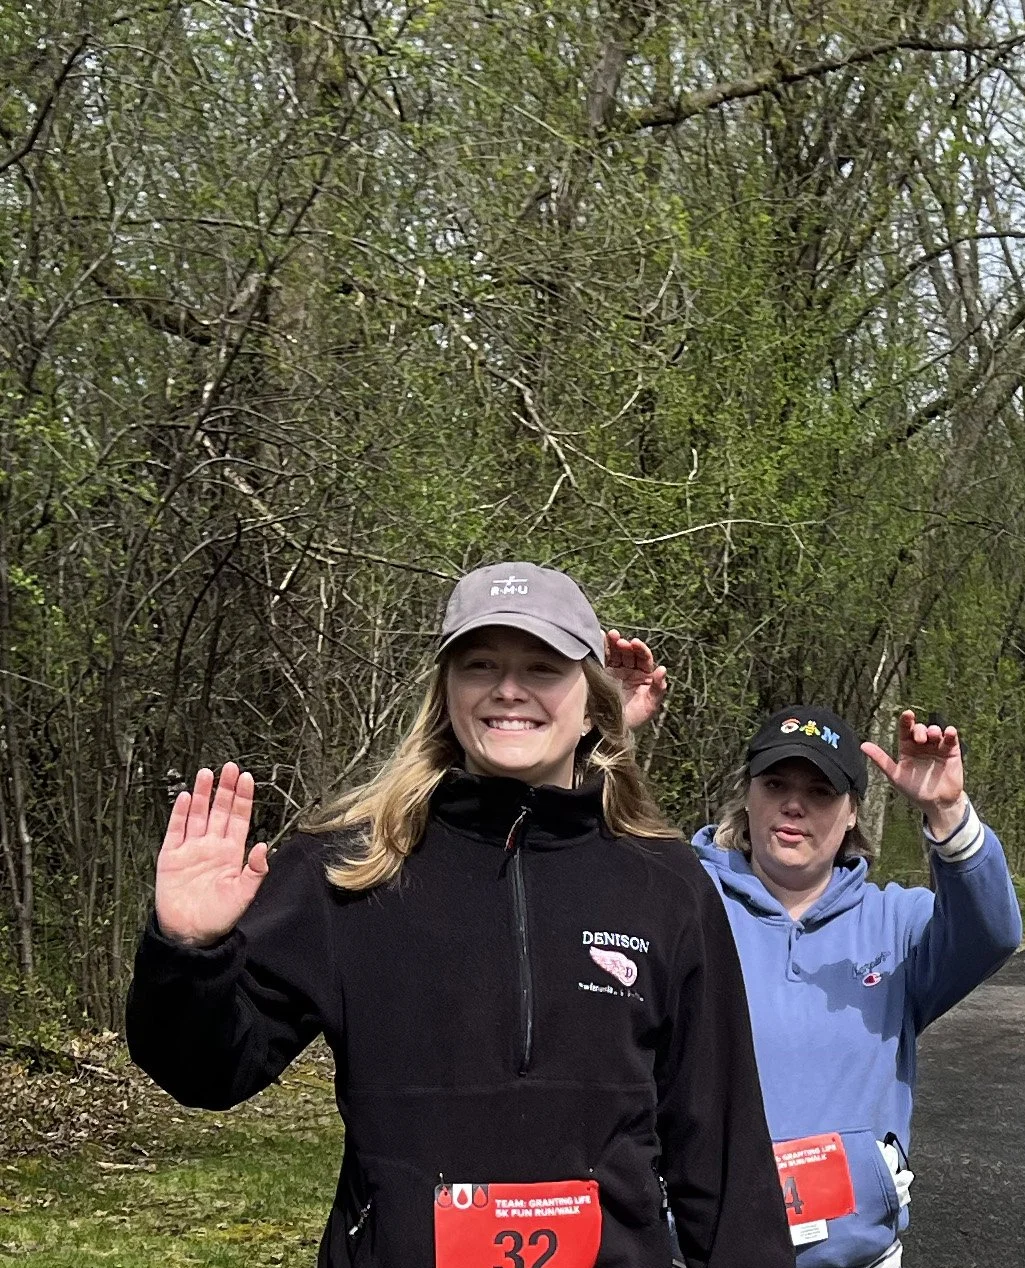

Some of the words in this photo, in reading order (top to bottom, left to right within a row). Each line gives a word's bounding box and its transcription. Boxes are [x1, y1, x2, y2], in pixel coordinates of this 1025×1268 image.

[582, 931, 650, 953] DENISON
[495, 1199, 527, 1208] TEAM:
[528, 1197, 573, 1208] GRANTING
[574, 1195, 591, 1205] LIFE
[495, 1208, 509, 1218] 5K
[511, 1208, 533, 1218] FUN
[534, 1205, 580, 1217] RUN/WALK
